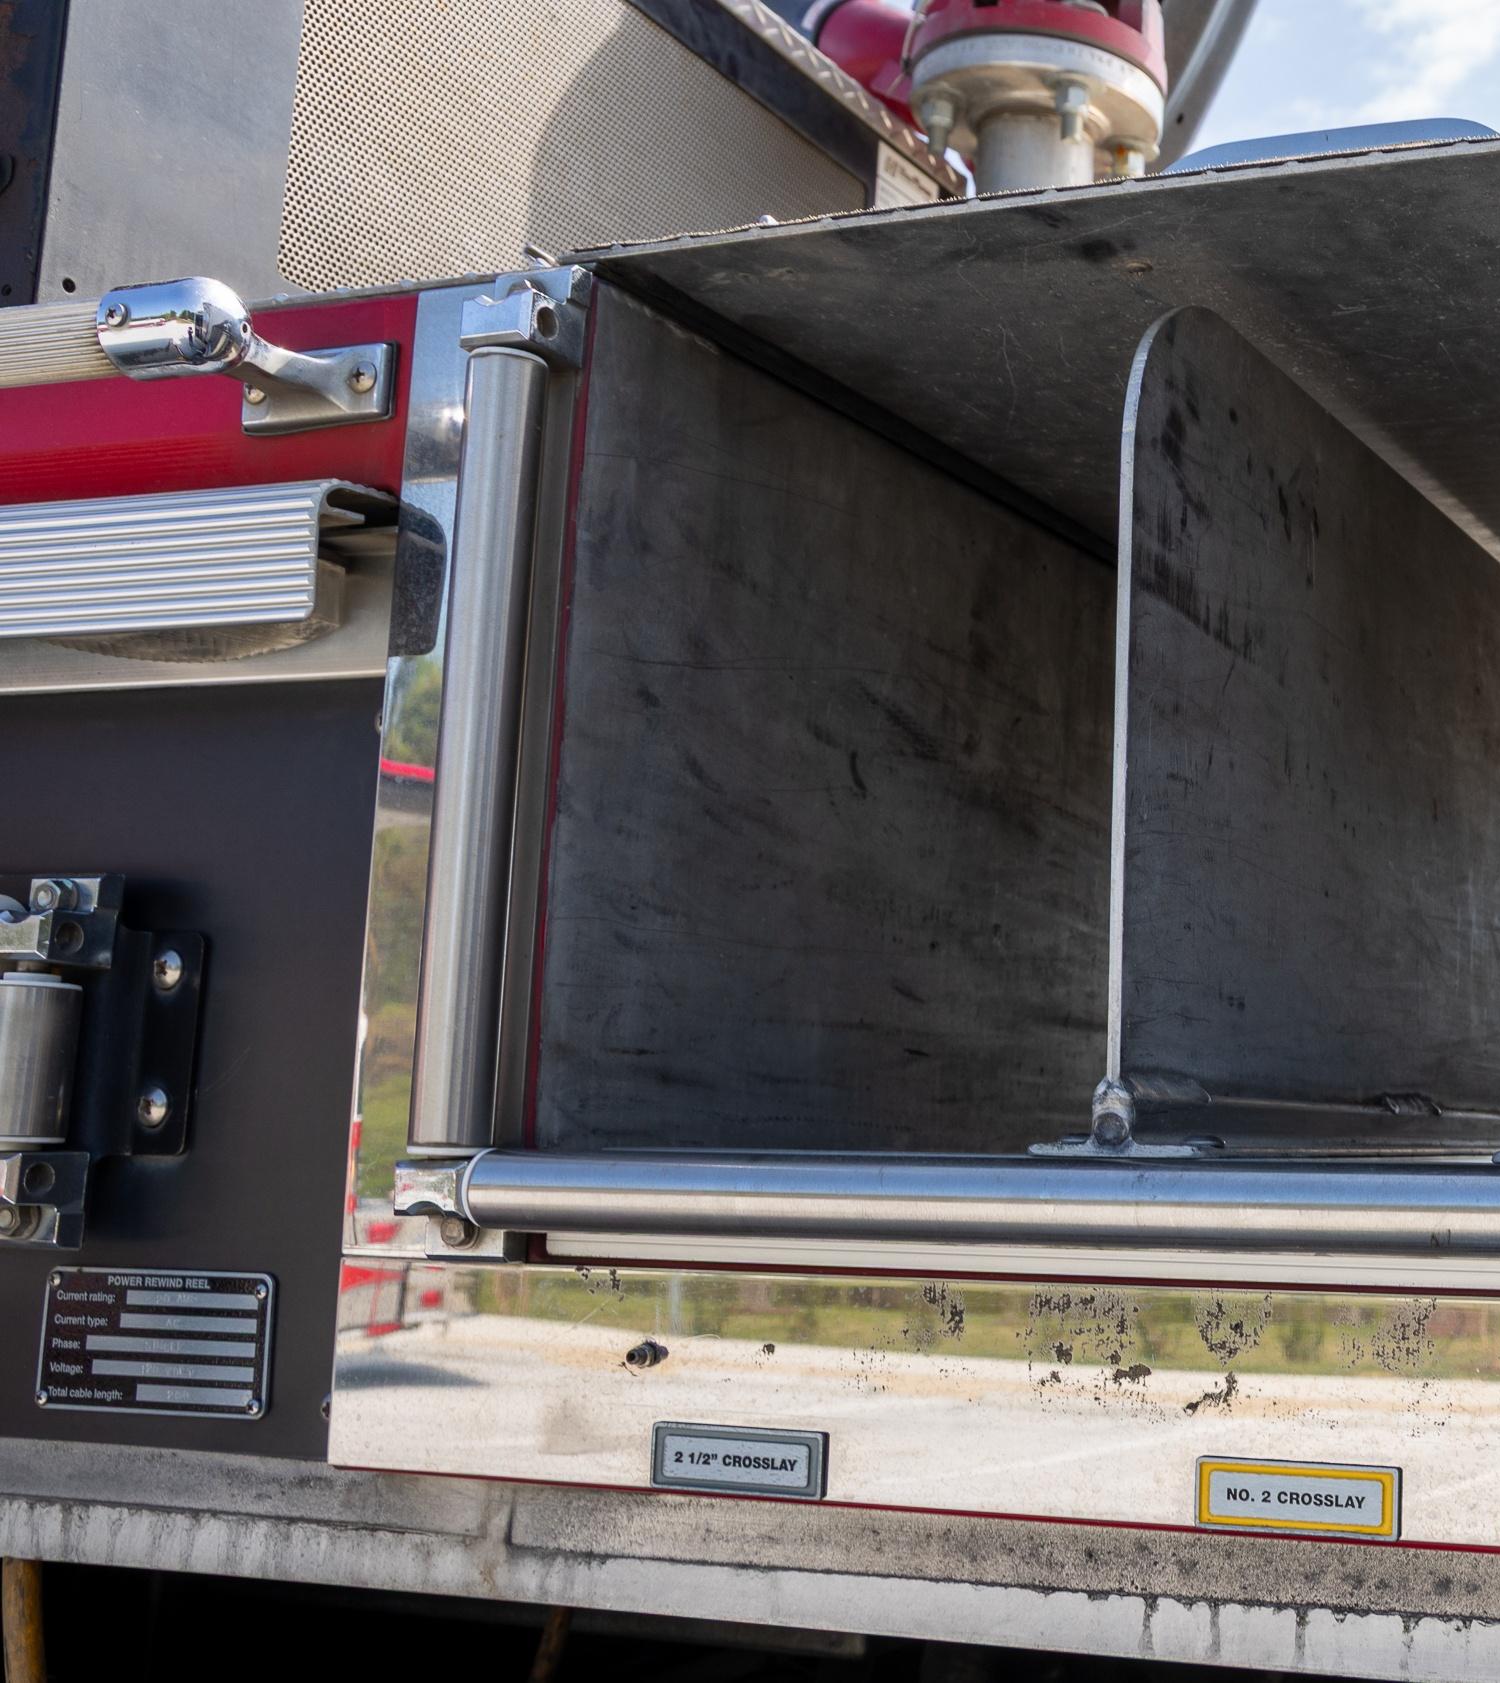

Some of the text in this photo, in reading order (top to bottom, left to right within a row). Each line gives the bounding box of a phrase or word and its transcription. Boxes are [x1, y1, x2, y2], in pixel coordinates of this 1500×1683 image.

[108, 1275, 210, 1289] POWER REWIND REEL
[56, 1289, 116, 1304] Current rating:
[54, 1313, 108, 1328] Current type:
[52, 1337, 81, 1350] Phase:
[50, 1361, 83, 1376] Voltage:
[48, 1385, 123, 1402] Total cable length:
[674, 1451, 683, 1463] 2
[722, 1454, 797, 1472] CROSSLAY
[1226, 1487, 1366, 1509] NO. 2 CROSSLAY
